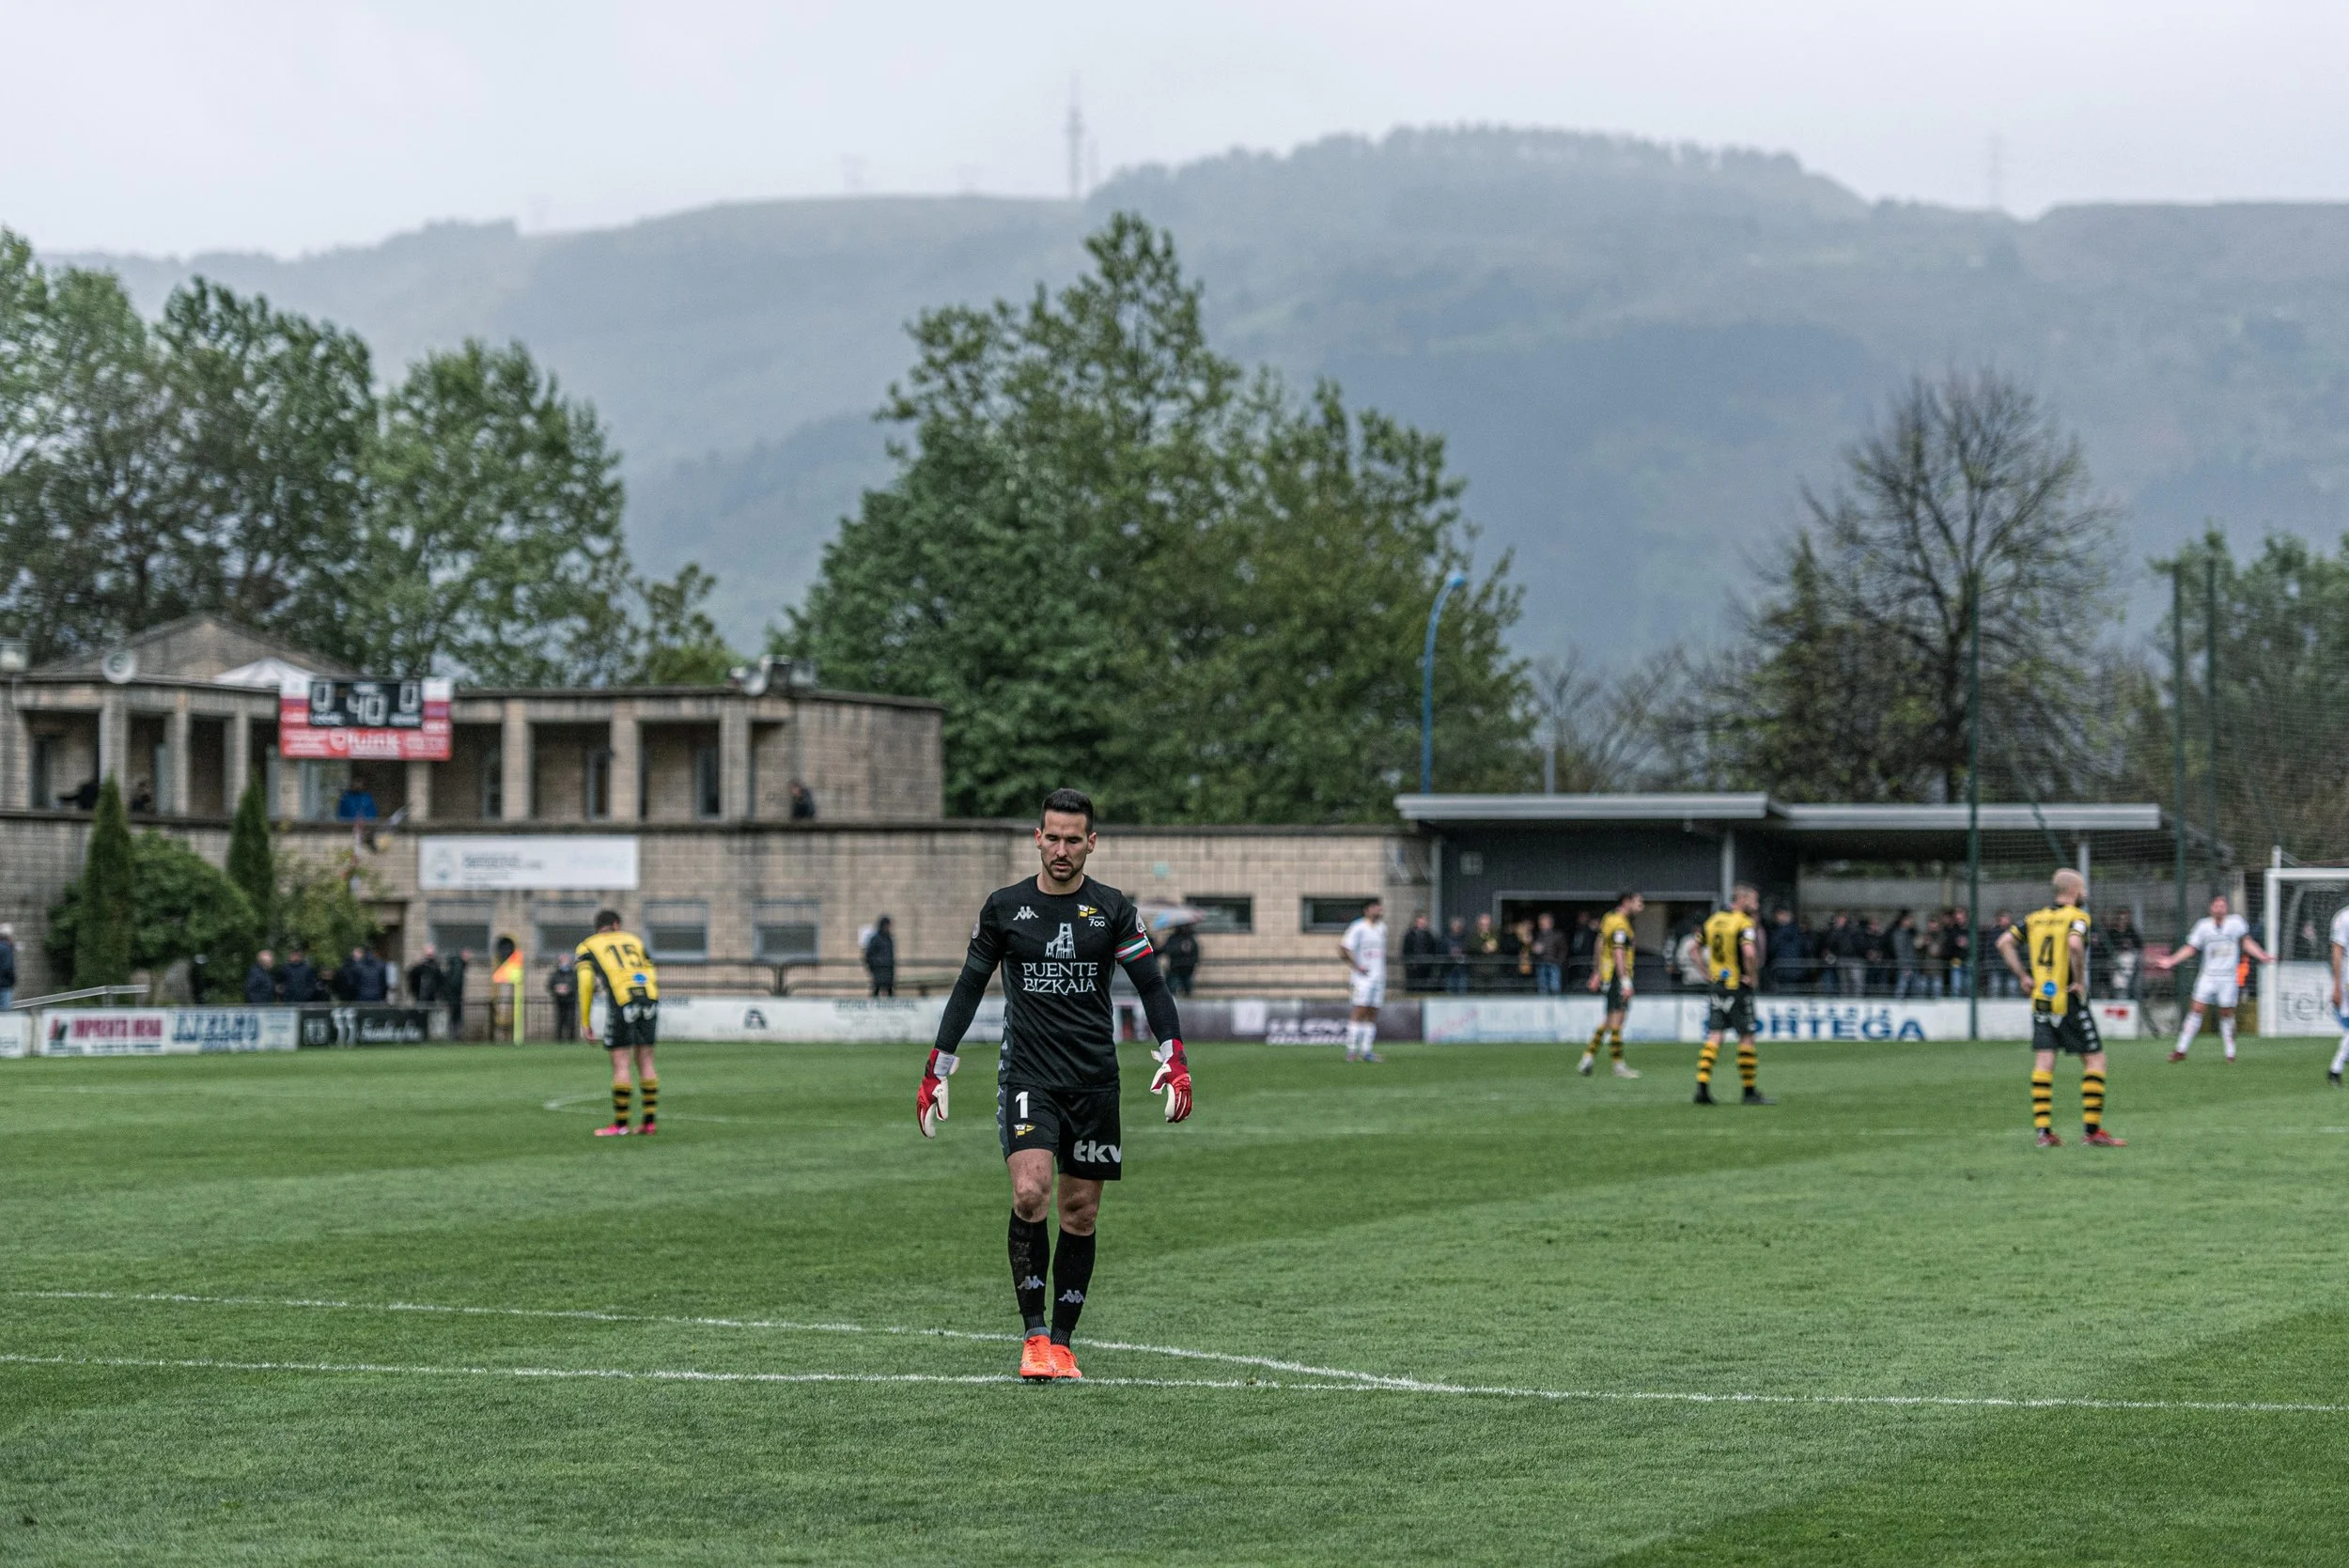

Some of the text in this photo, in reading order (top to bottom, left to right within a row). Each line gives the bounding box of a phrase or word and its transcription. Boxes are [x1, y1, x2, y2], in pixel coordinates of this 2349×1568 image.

[311, 682, 334, 712] 0
[346, 694, 387, 726] 40
[398, 681, 421, 712] 0
[604, 944, 643, 969] 15
[2036, 936, 2055, 971] 4
[1021, 962, 1098, 977] PUENTE
[1022, 978, 1097, 996] BIZKAIA
[1016, 1092, 1029, 1119] 1
